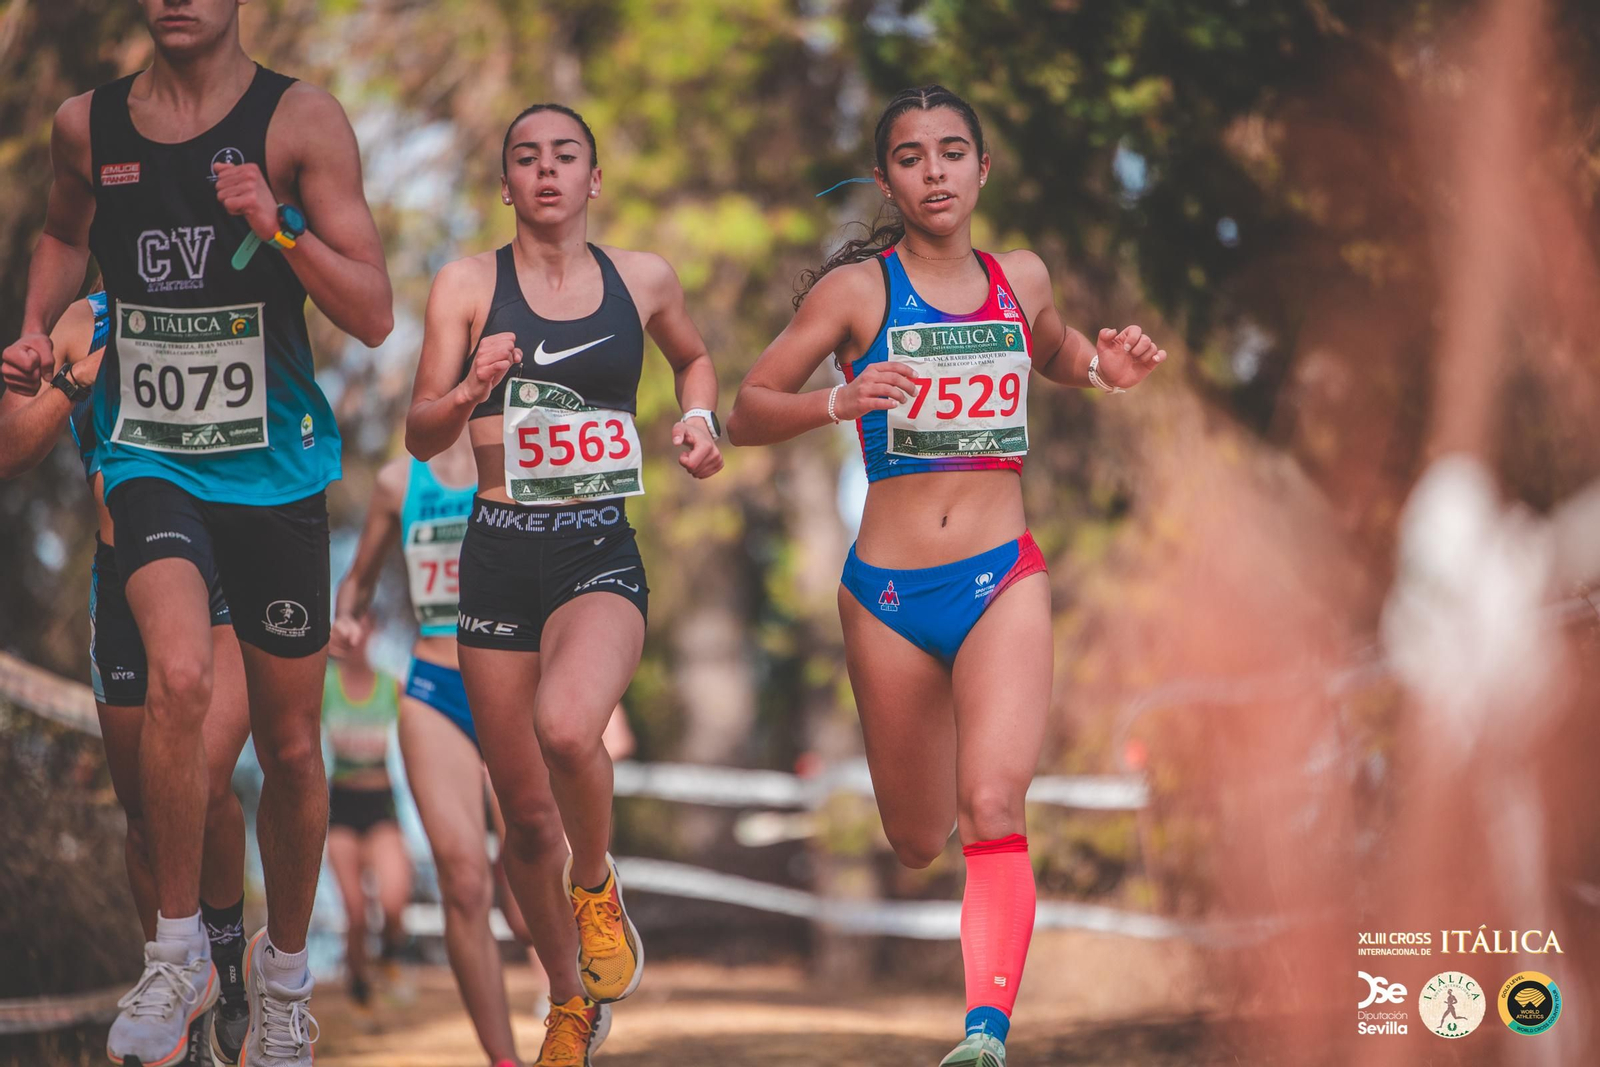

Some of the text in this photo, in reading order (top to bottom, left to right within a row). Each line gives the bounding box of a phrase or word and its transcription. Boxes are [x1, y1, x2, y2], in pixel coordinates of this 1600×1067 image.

[153, 314, 221, 333] ITÁLICA
[931, 328, 997, 346] ITÁLICA
[216, 339, 244, 348] MANUEL
[133, 362, 254, 412] 6079
[907, 373, 1020, 420] 7529
[518, 419, 630, 468] 5563
[476, 505, 620, 532] NIKE PRO
[419, 560, 460, 595] 75
[458, 610, 518, 636] NIKE
